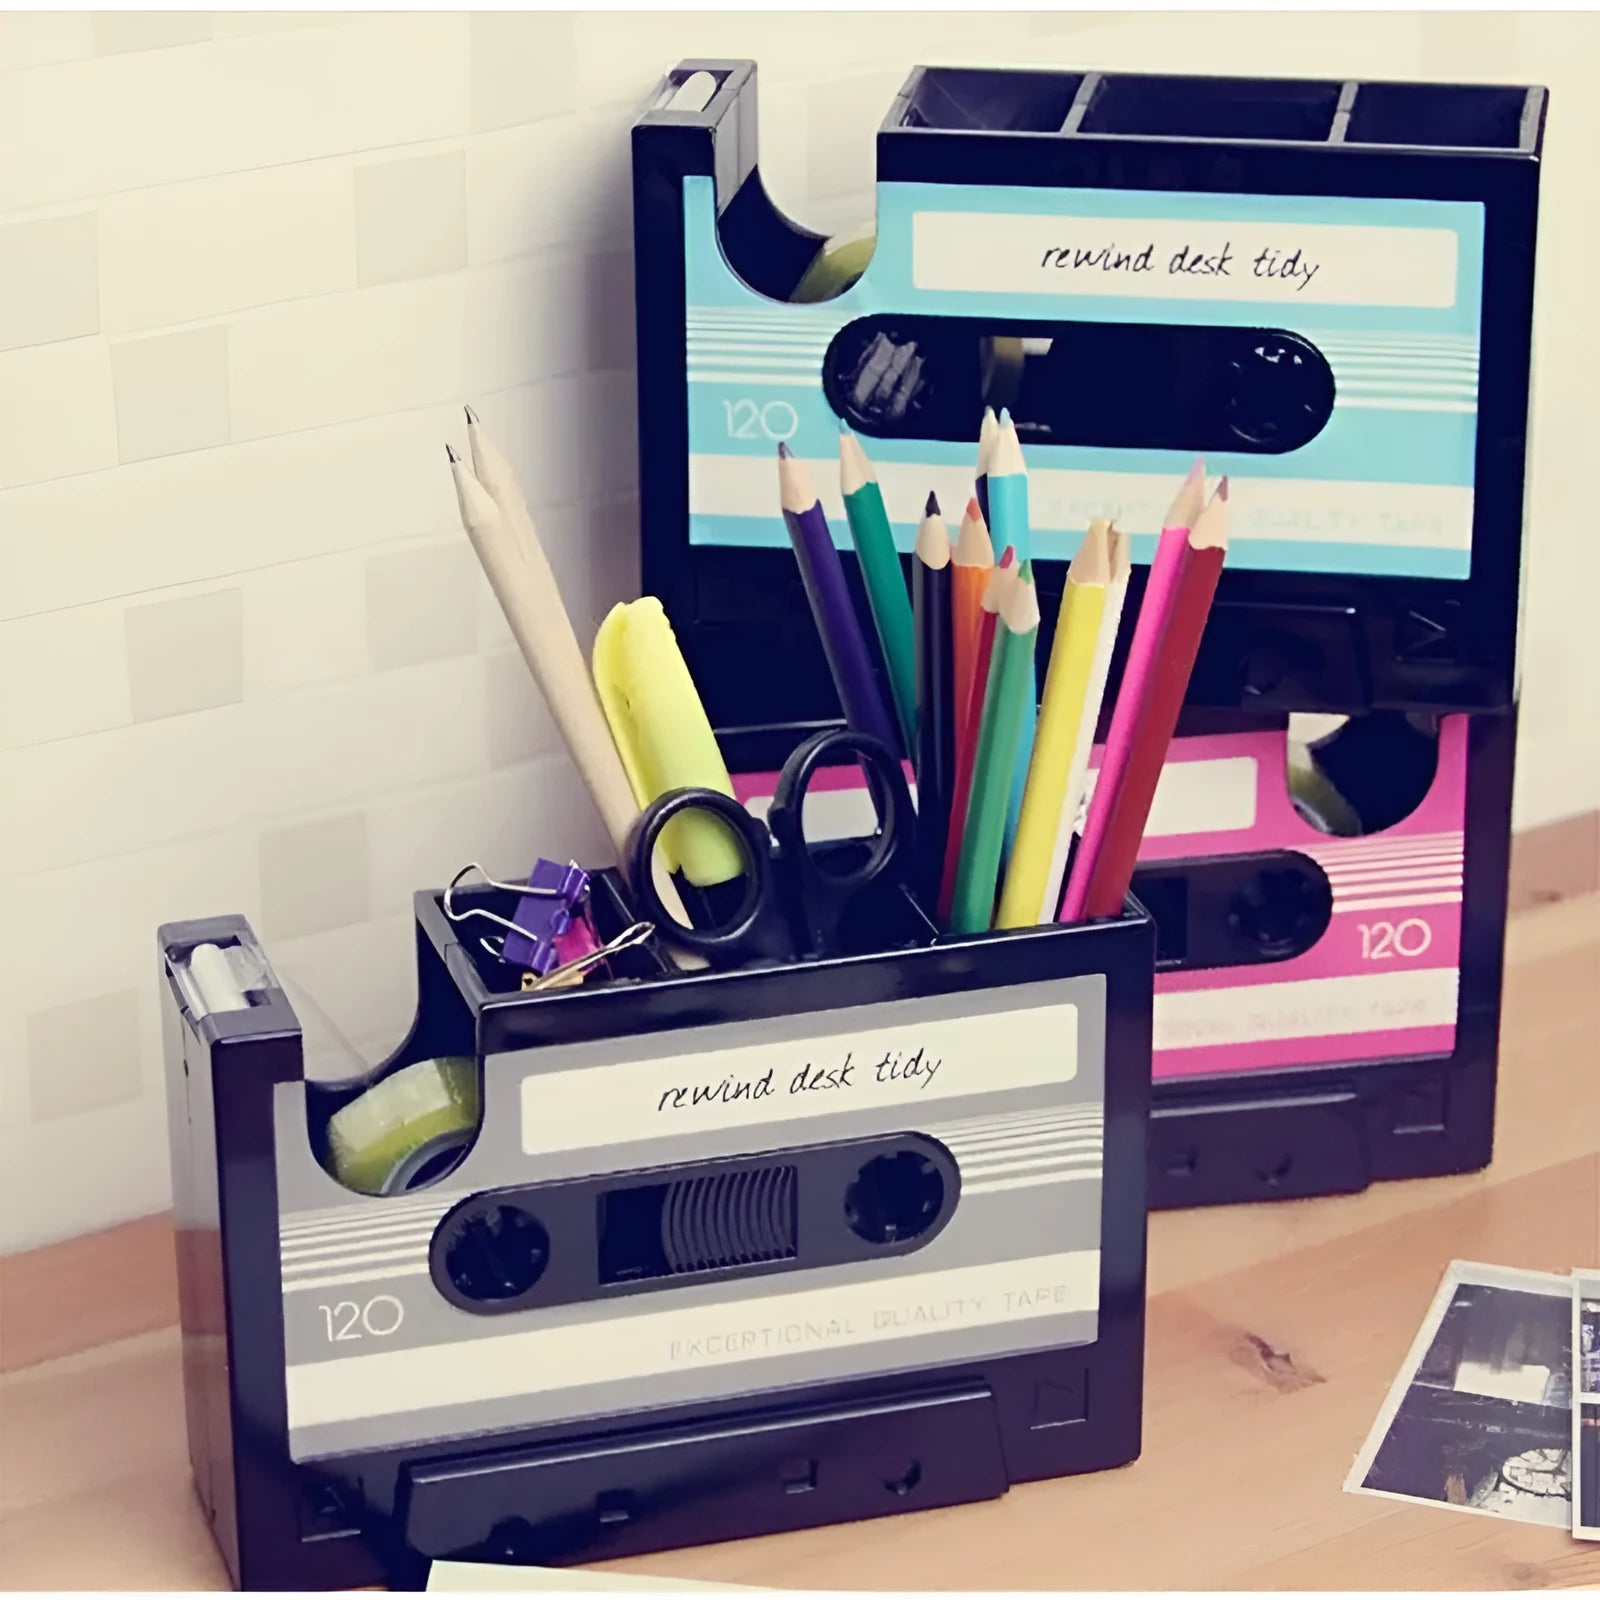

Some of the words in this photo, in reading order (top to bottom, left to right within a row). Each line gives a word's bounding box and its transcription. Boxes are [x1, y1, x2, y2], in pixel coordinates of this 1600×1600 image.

[1041, 243, 1154, 272] rewind
[1168, 241, 1234, 276] desk
[1253, 246, 1320, 292] tidy
[721, 398, 799, 441] 120
[1356, 917, 1432, 960] 120
[657, 1068, 775, 1112] rewind
[788, 1051, 856, 1095] desk
[874, 1046, 943, 1090] tidy
[318, 1294, 405, 1342] 120
